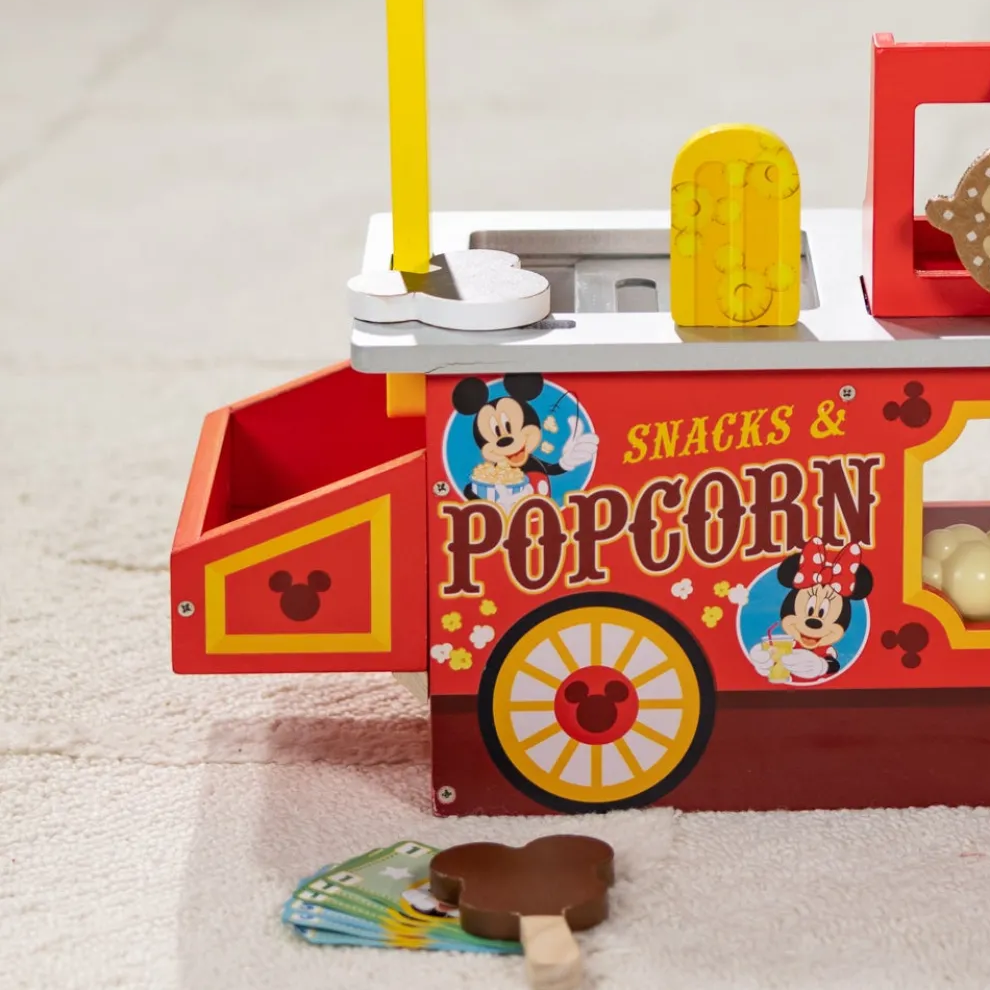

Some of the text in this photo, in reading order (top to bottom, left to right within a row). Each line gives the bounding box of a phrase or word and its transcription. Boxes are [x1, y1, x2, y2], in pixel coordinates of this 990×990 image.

[622, 399, 846, 464] SNACKS &
[440, 455, 883, 596] POPCORN
[406, 846, 421, 854] 1
